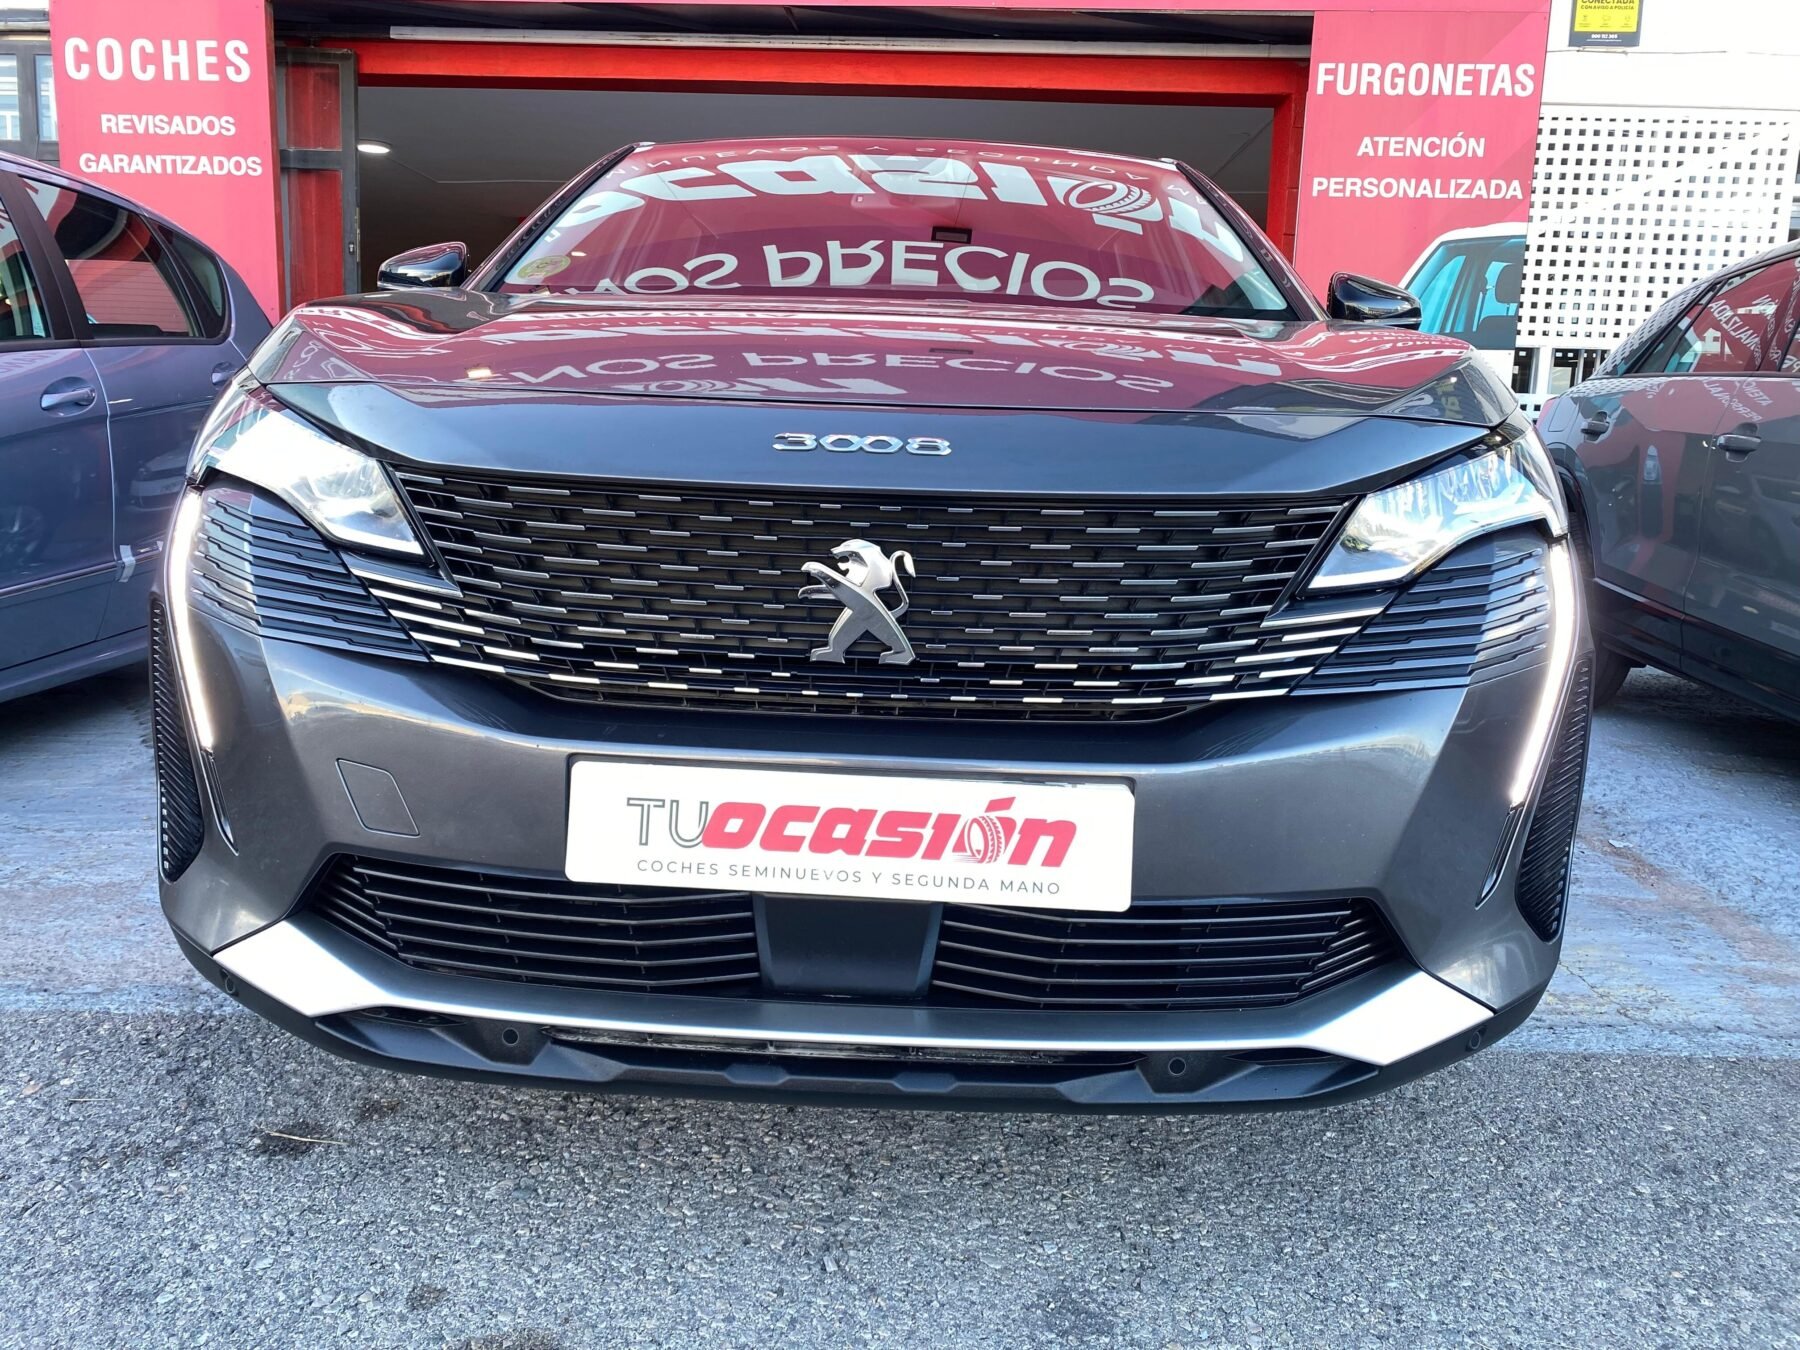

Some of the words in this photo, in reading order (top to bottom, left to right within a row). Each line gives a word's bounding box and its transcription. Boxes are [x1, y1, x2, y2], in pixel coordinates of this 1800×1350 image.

[64, 37, 251, 82] COCHES
[1316, 63, 1535, 97] FURGONETAS
[100, 114, 236, 137] REVISADOS
[1356, 131, 1486, 158] ATENCIÓN
[79, 153, 263, 177] GARANTIZADOS
[1312, 178, 1523, 200] PERSONALIZADA
[772, 432, 952, 456] 3008
[637, 859, 719, 875] COCHES
[729, 864, 861, 883] SEMINUEVOS
[872, 872, 882, 884] Y
[892, 873, 990, 890] SEGUNDA
[1000, 879, 1060, 895] MANO
